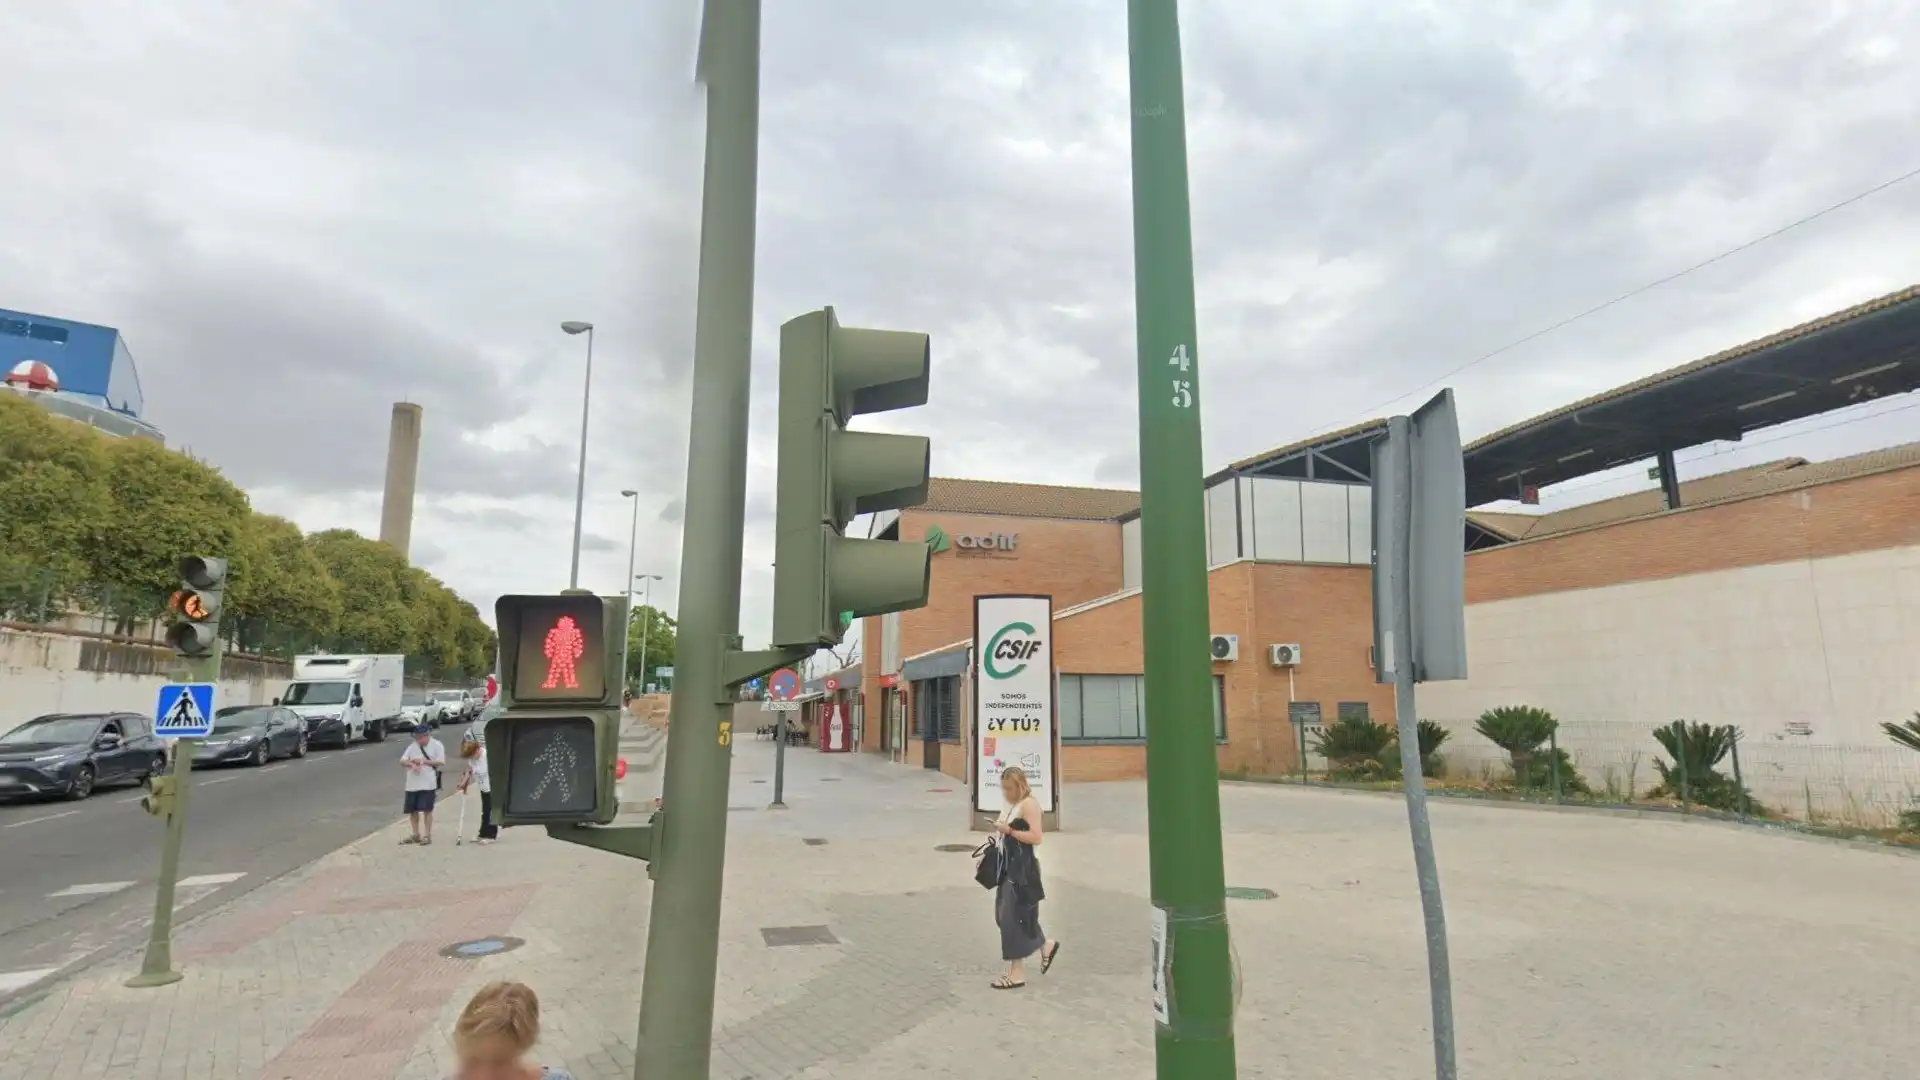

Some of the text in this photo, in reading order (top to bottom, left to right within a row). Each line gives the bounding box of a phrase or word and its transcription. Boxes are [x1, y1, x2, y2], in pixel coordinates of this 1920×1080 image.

[1169, 344, 1190, 372] 4
[1172, 380, 1192, 408] 5
[956, 531, 1019, 551] adif
[995, 639, 1042, 660] CSIF
[988, 714, 1040, 731] ¿Y TÚ?
